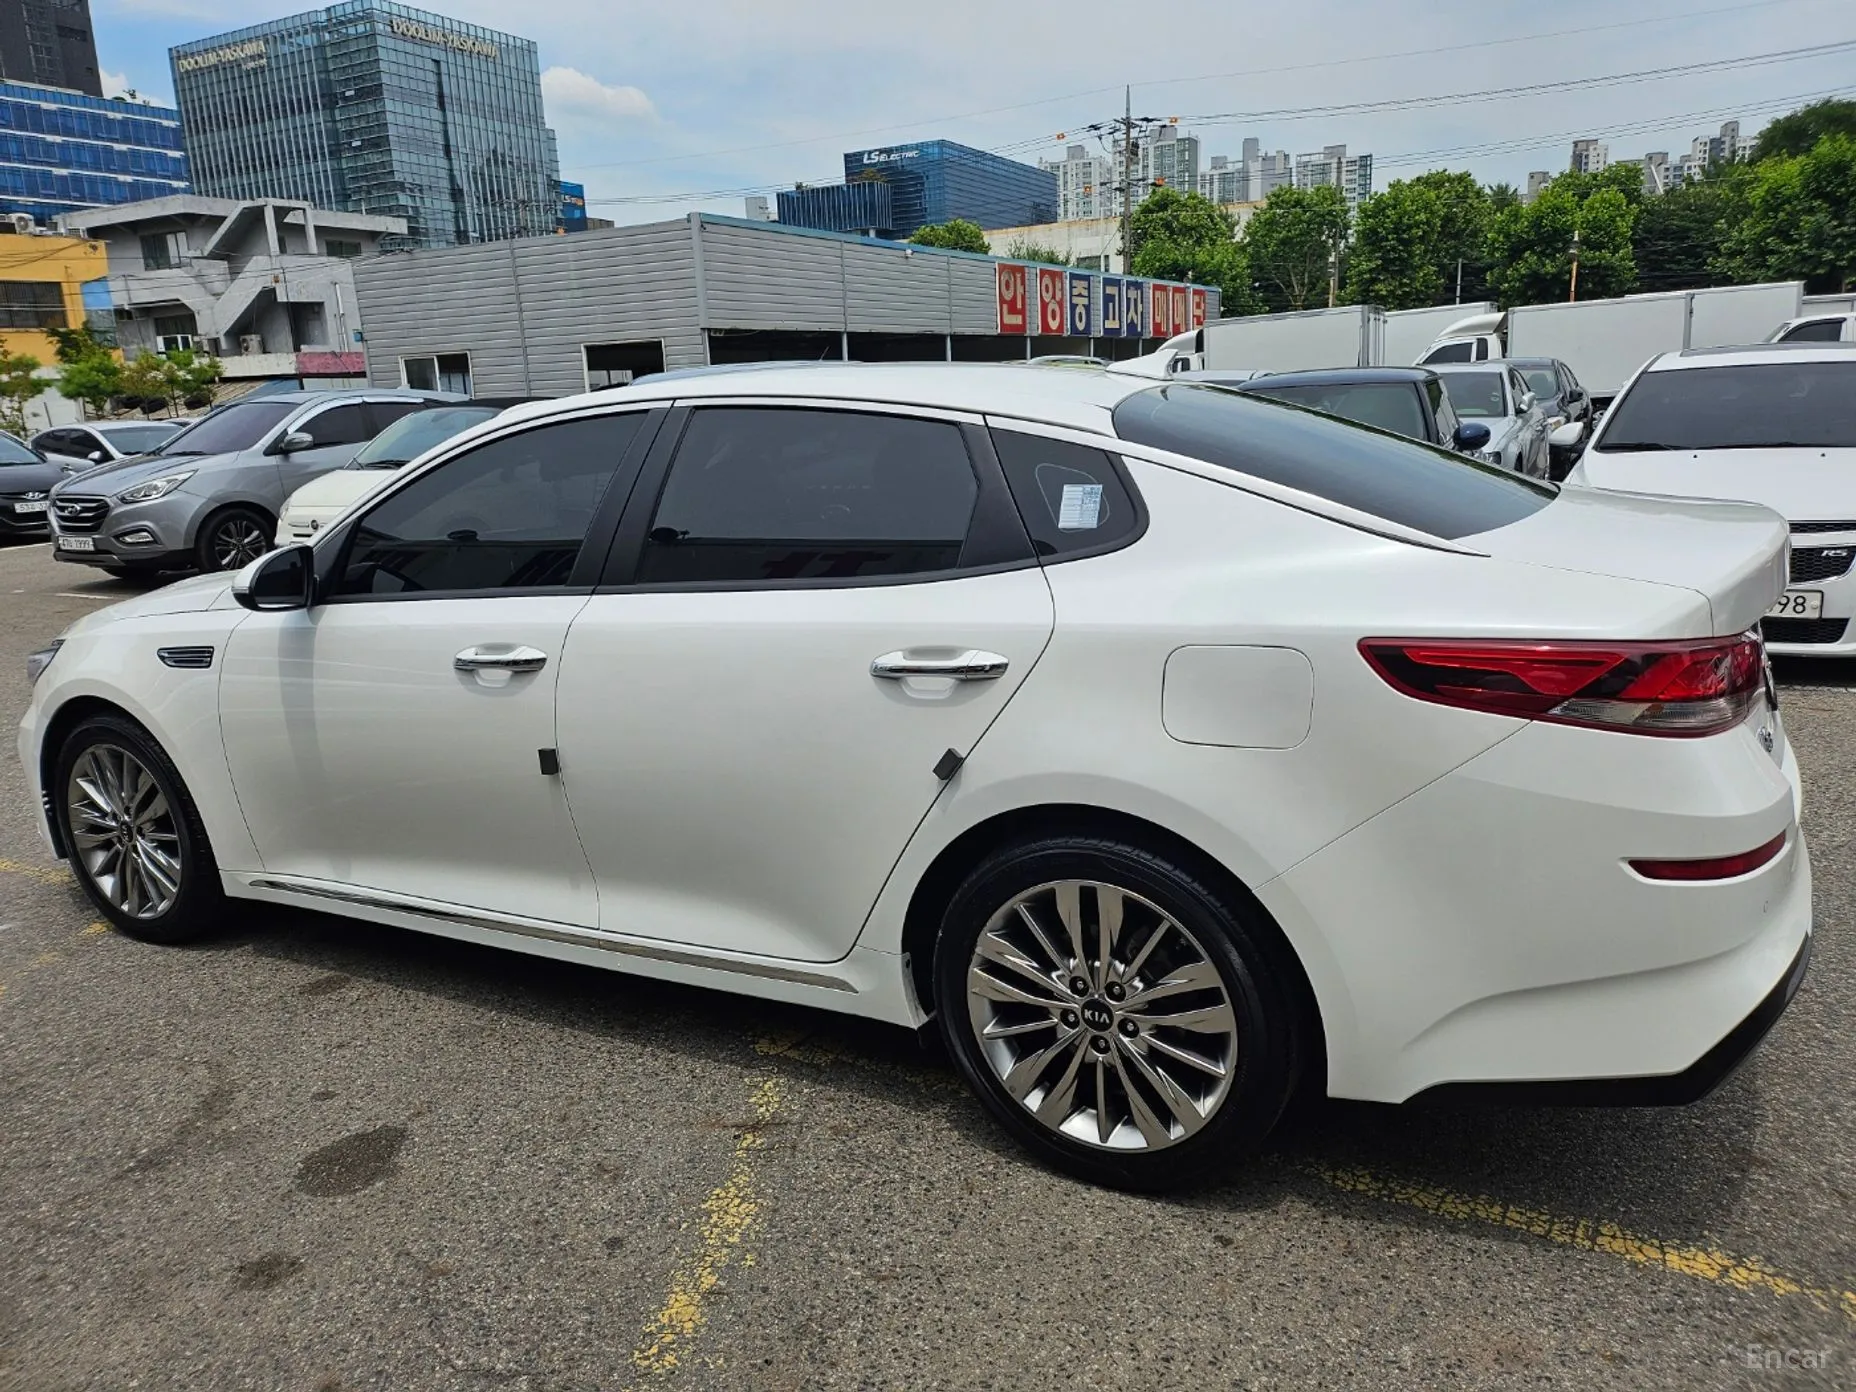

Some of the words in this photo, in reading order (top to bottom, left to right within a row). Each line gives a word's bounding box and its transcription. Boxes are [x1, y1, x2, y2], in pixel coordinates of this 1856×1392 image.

[179, 40, 266, 73] DOOLIM-YASKAWA
[863, 151, 880, 164] LS
[1085, 1009, 1110, 1024] KIA
